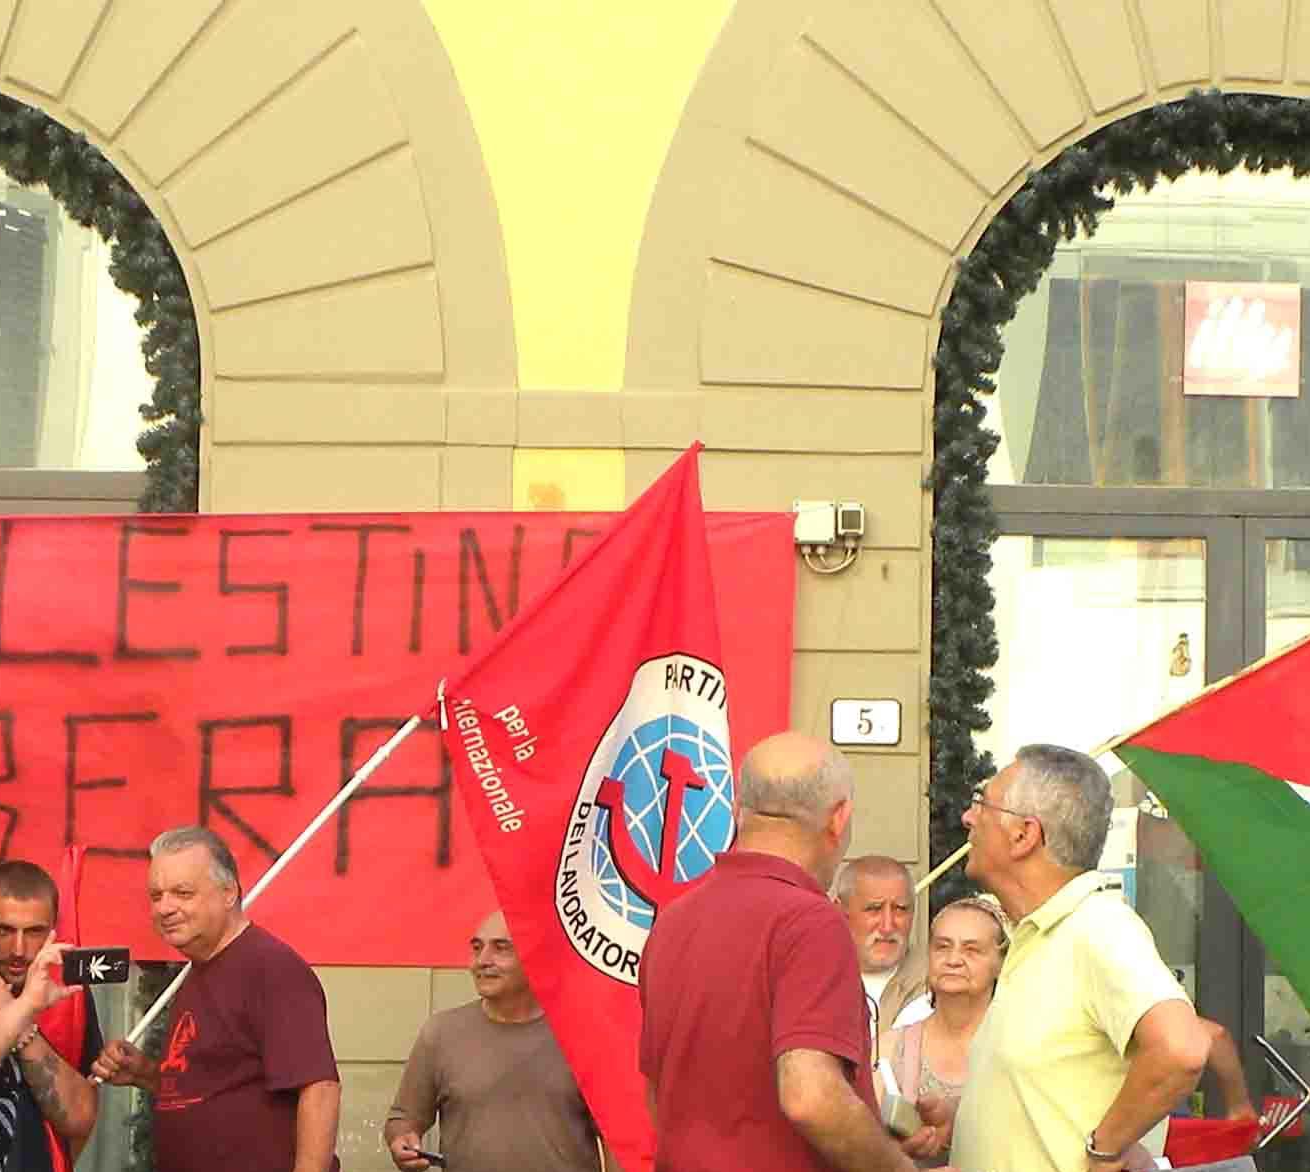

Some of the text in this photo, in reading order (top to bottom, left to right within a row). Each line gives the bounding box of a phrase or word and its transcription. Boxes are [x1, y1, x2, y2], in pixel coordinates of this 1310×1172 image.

[492, 704, 538, 763] per la
[857, 707, 873, 736] 5
[568, 802, 592, 845] DEI
